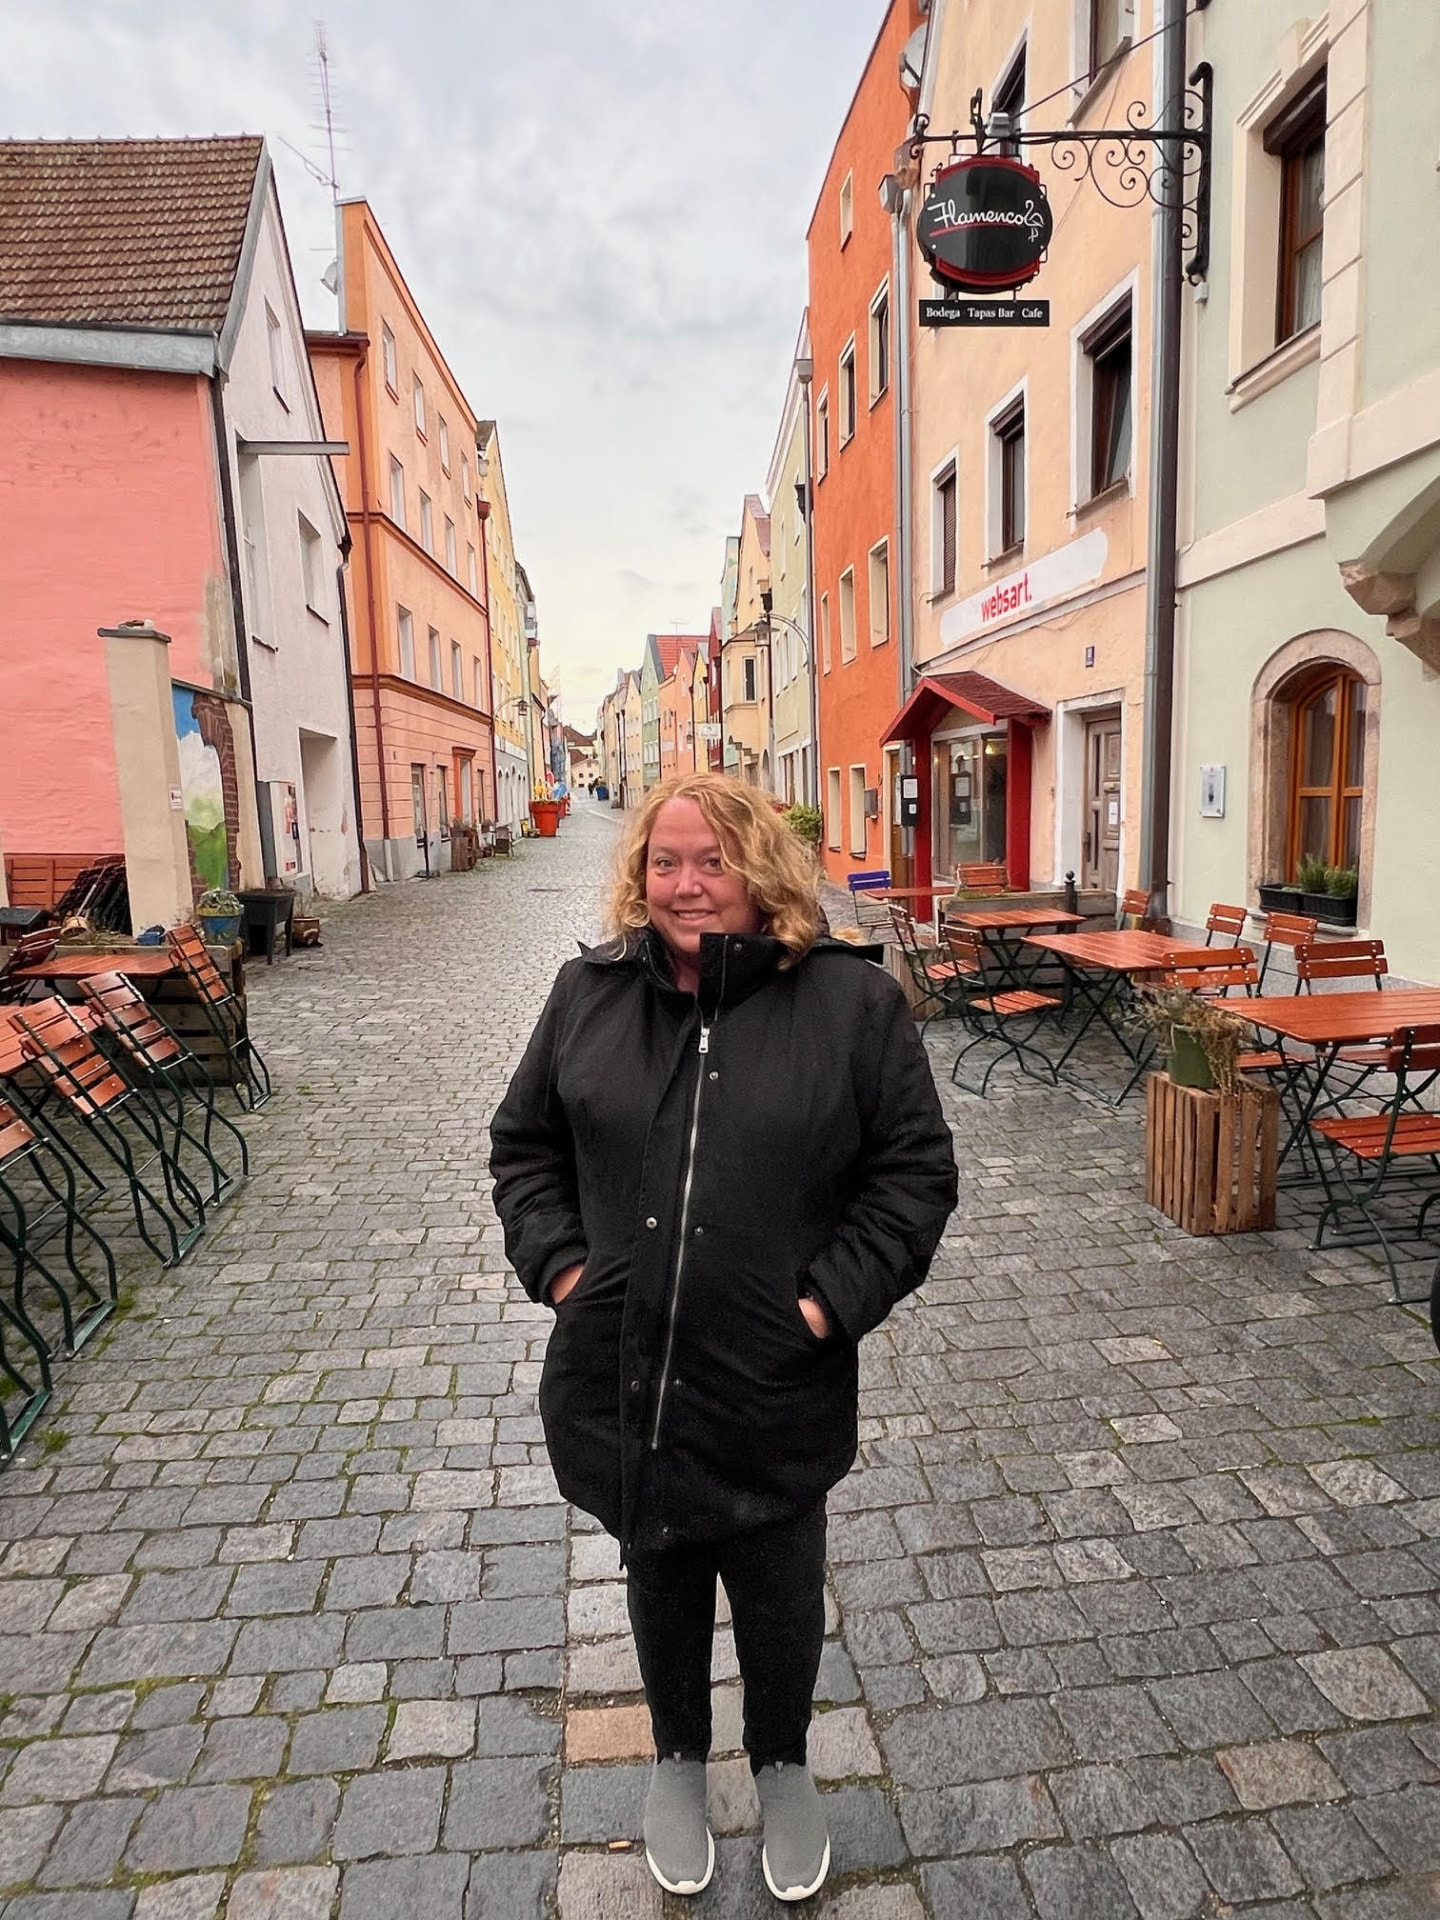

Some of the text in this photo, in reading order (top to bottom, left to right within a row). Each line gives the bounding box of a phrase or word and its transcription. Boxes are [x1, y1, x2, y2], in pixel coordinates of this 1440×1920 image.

[927, 199, 1025, 228] Flamenco
[926, 306, 1043, 320] Bodega Tapas Bar Cafe
[981, 572, 1032, 622] websart.
